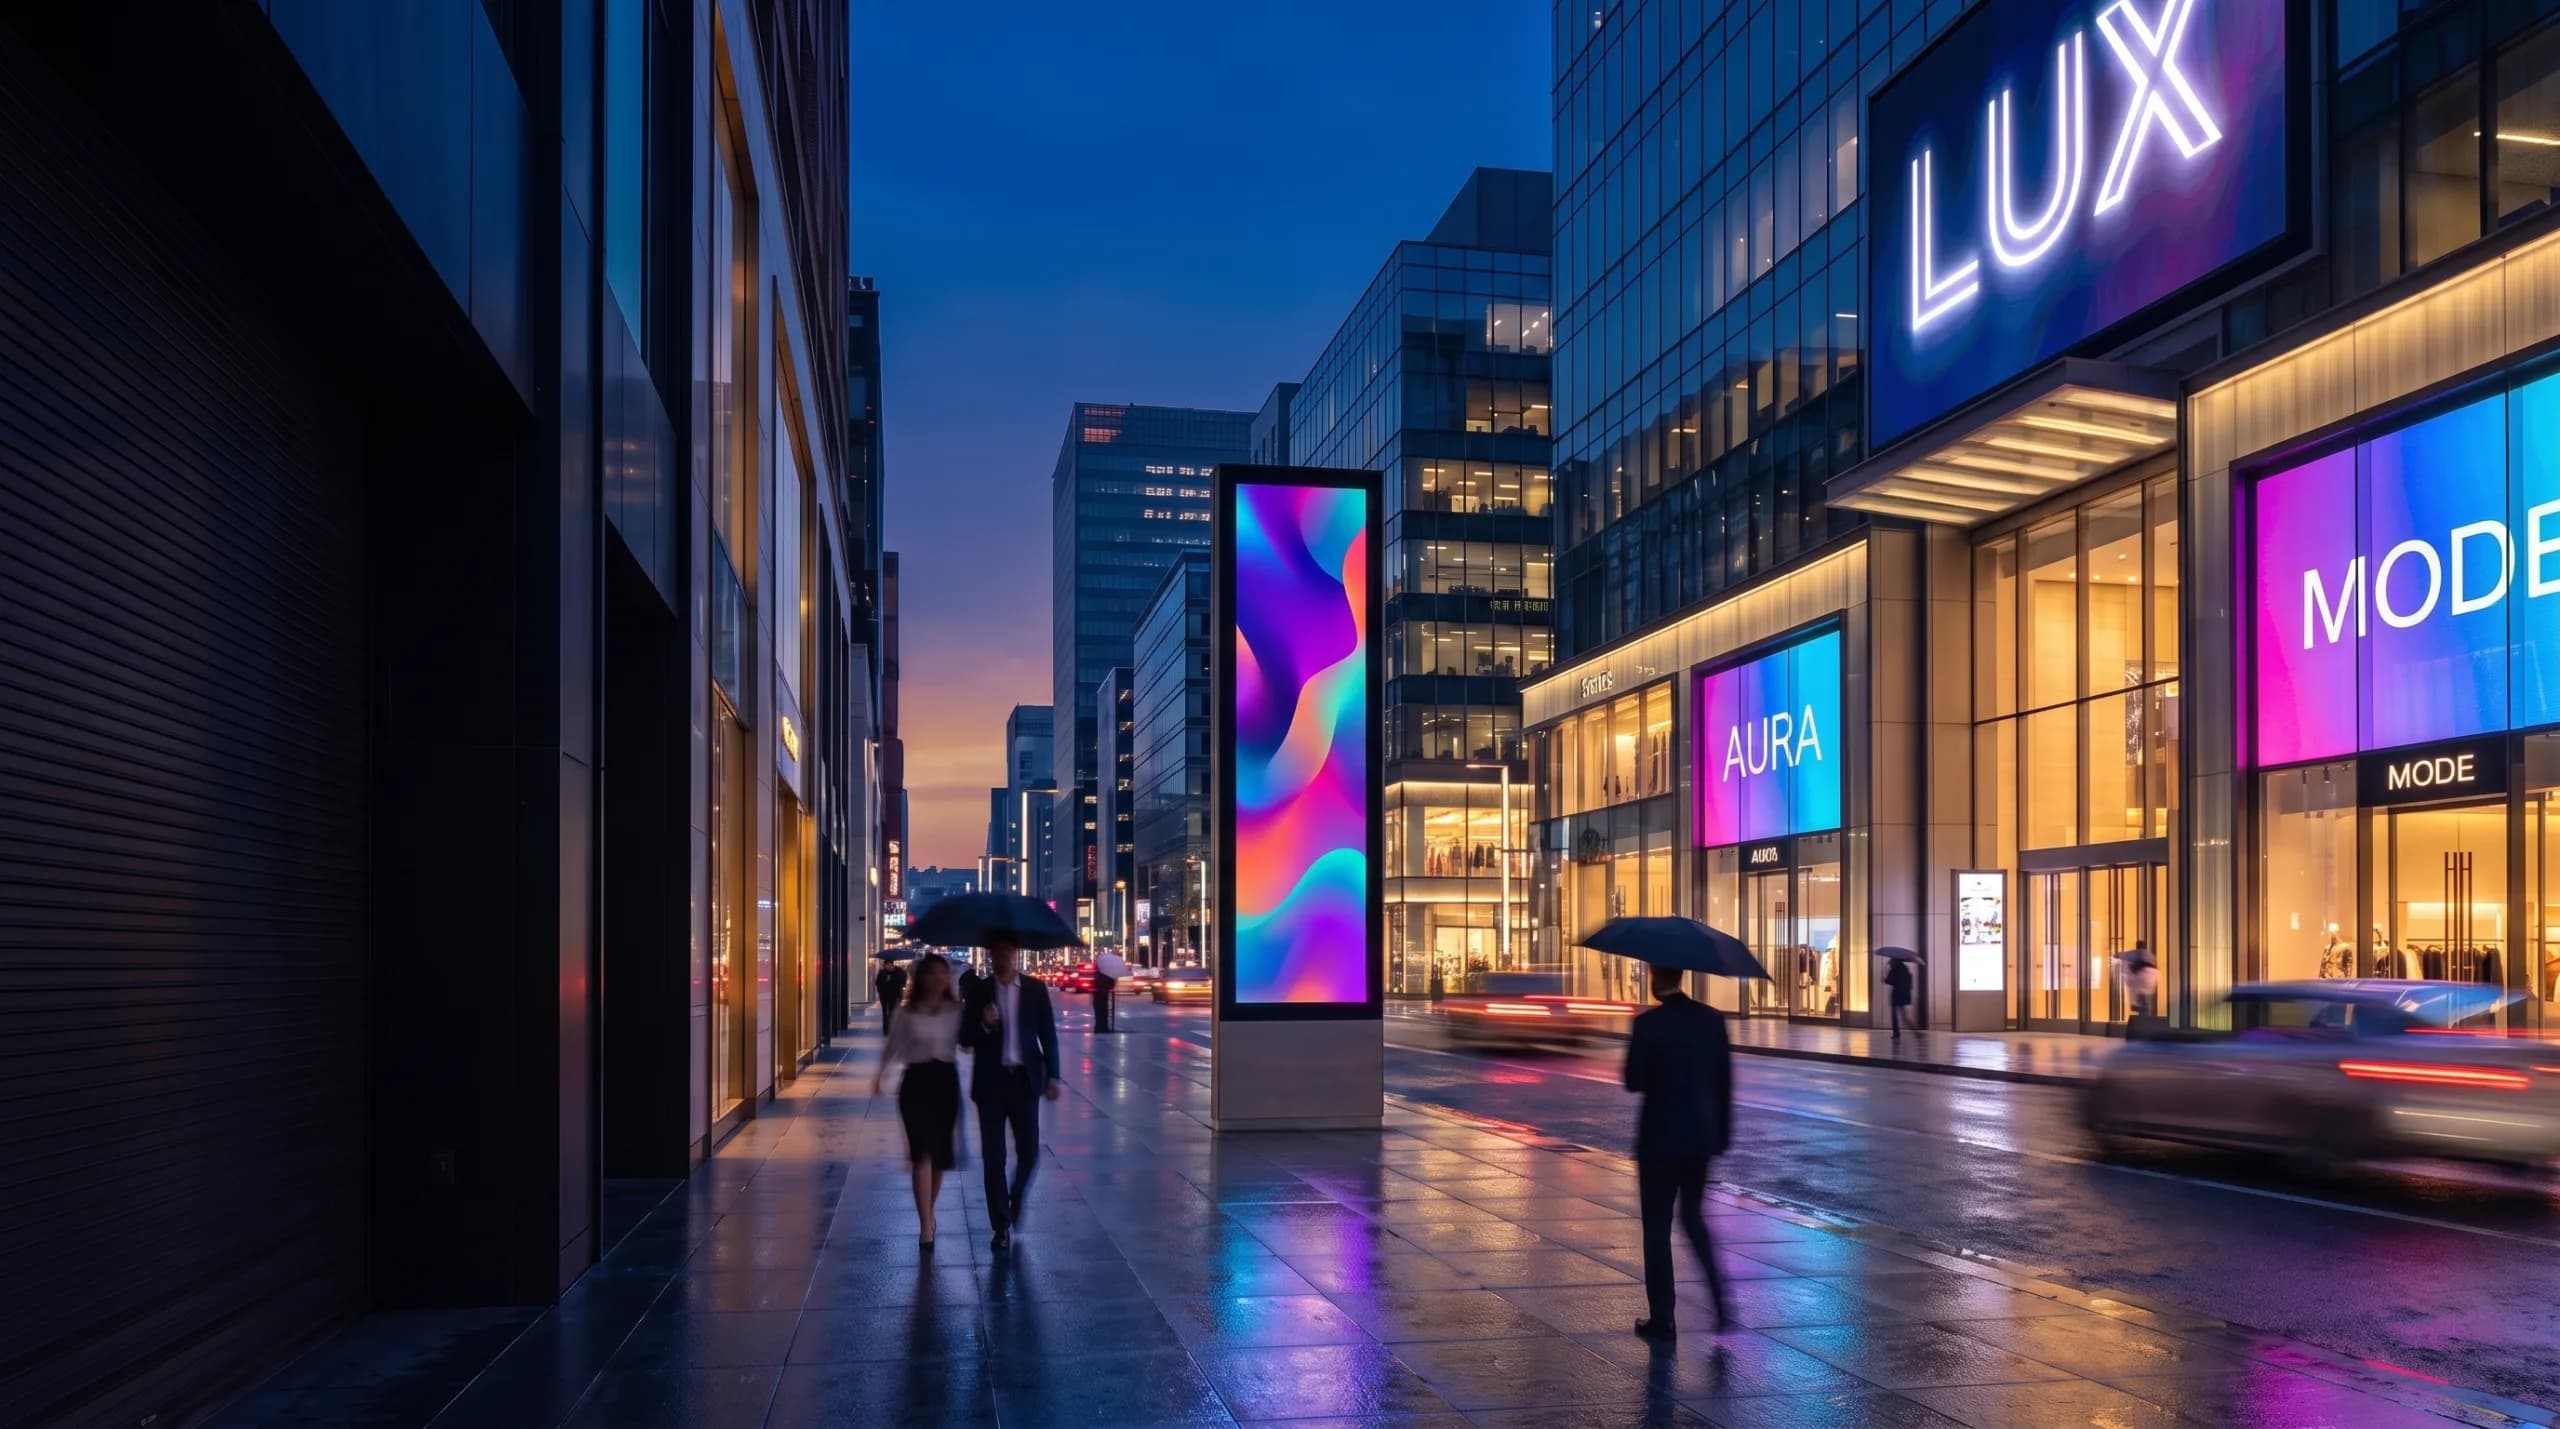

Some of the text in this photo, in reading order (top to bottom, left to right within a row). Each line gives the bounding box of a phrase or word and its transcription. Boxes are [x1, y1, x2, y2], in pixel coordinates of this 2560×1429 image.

[1910, 0, 2223, 333] LUX
[2302, 498, 2560, 651] MODE
[1723, 704, 1823, 783] AURA
[2388, 753, 2475, 791] MODE
